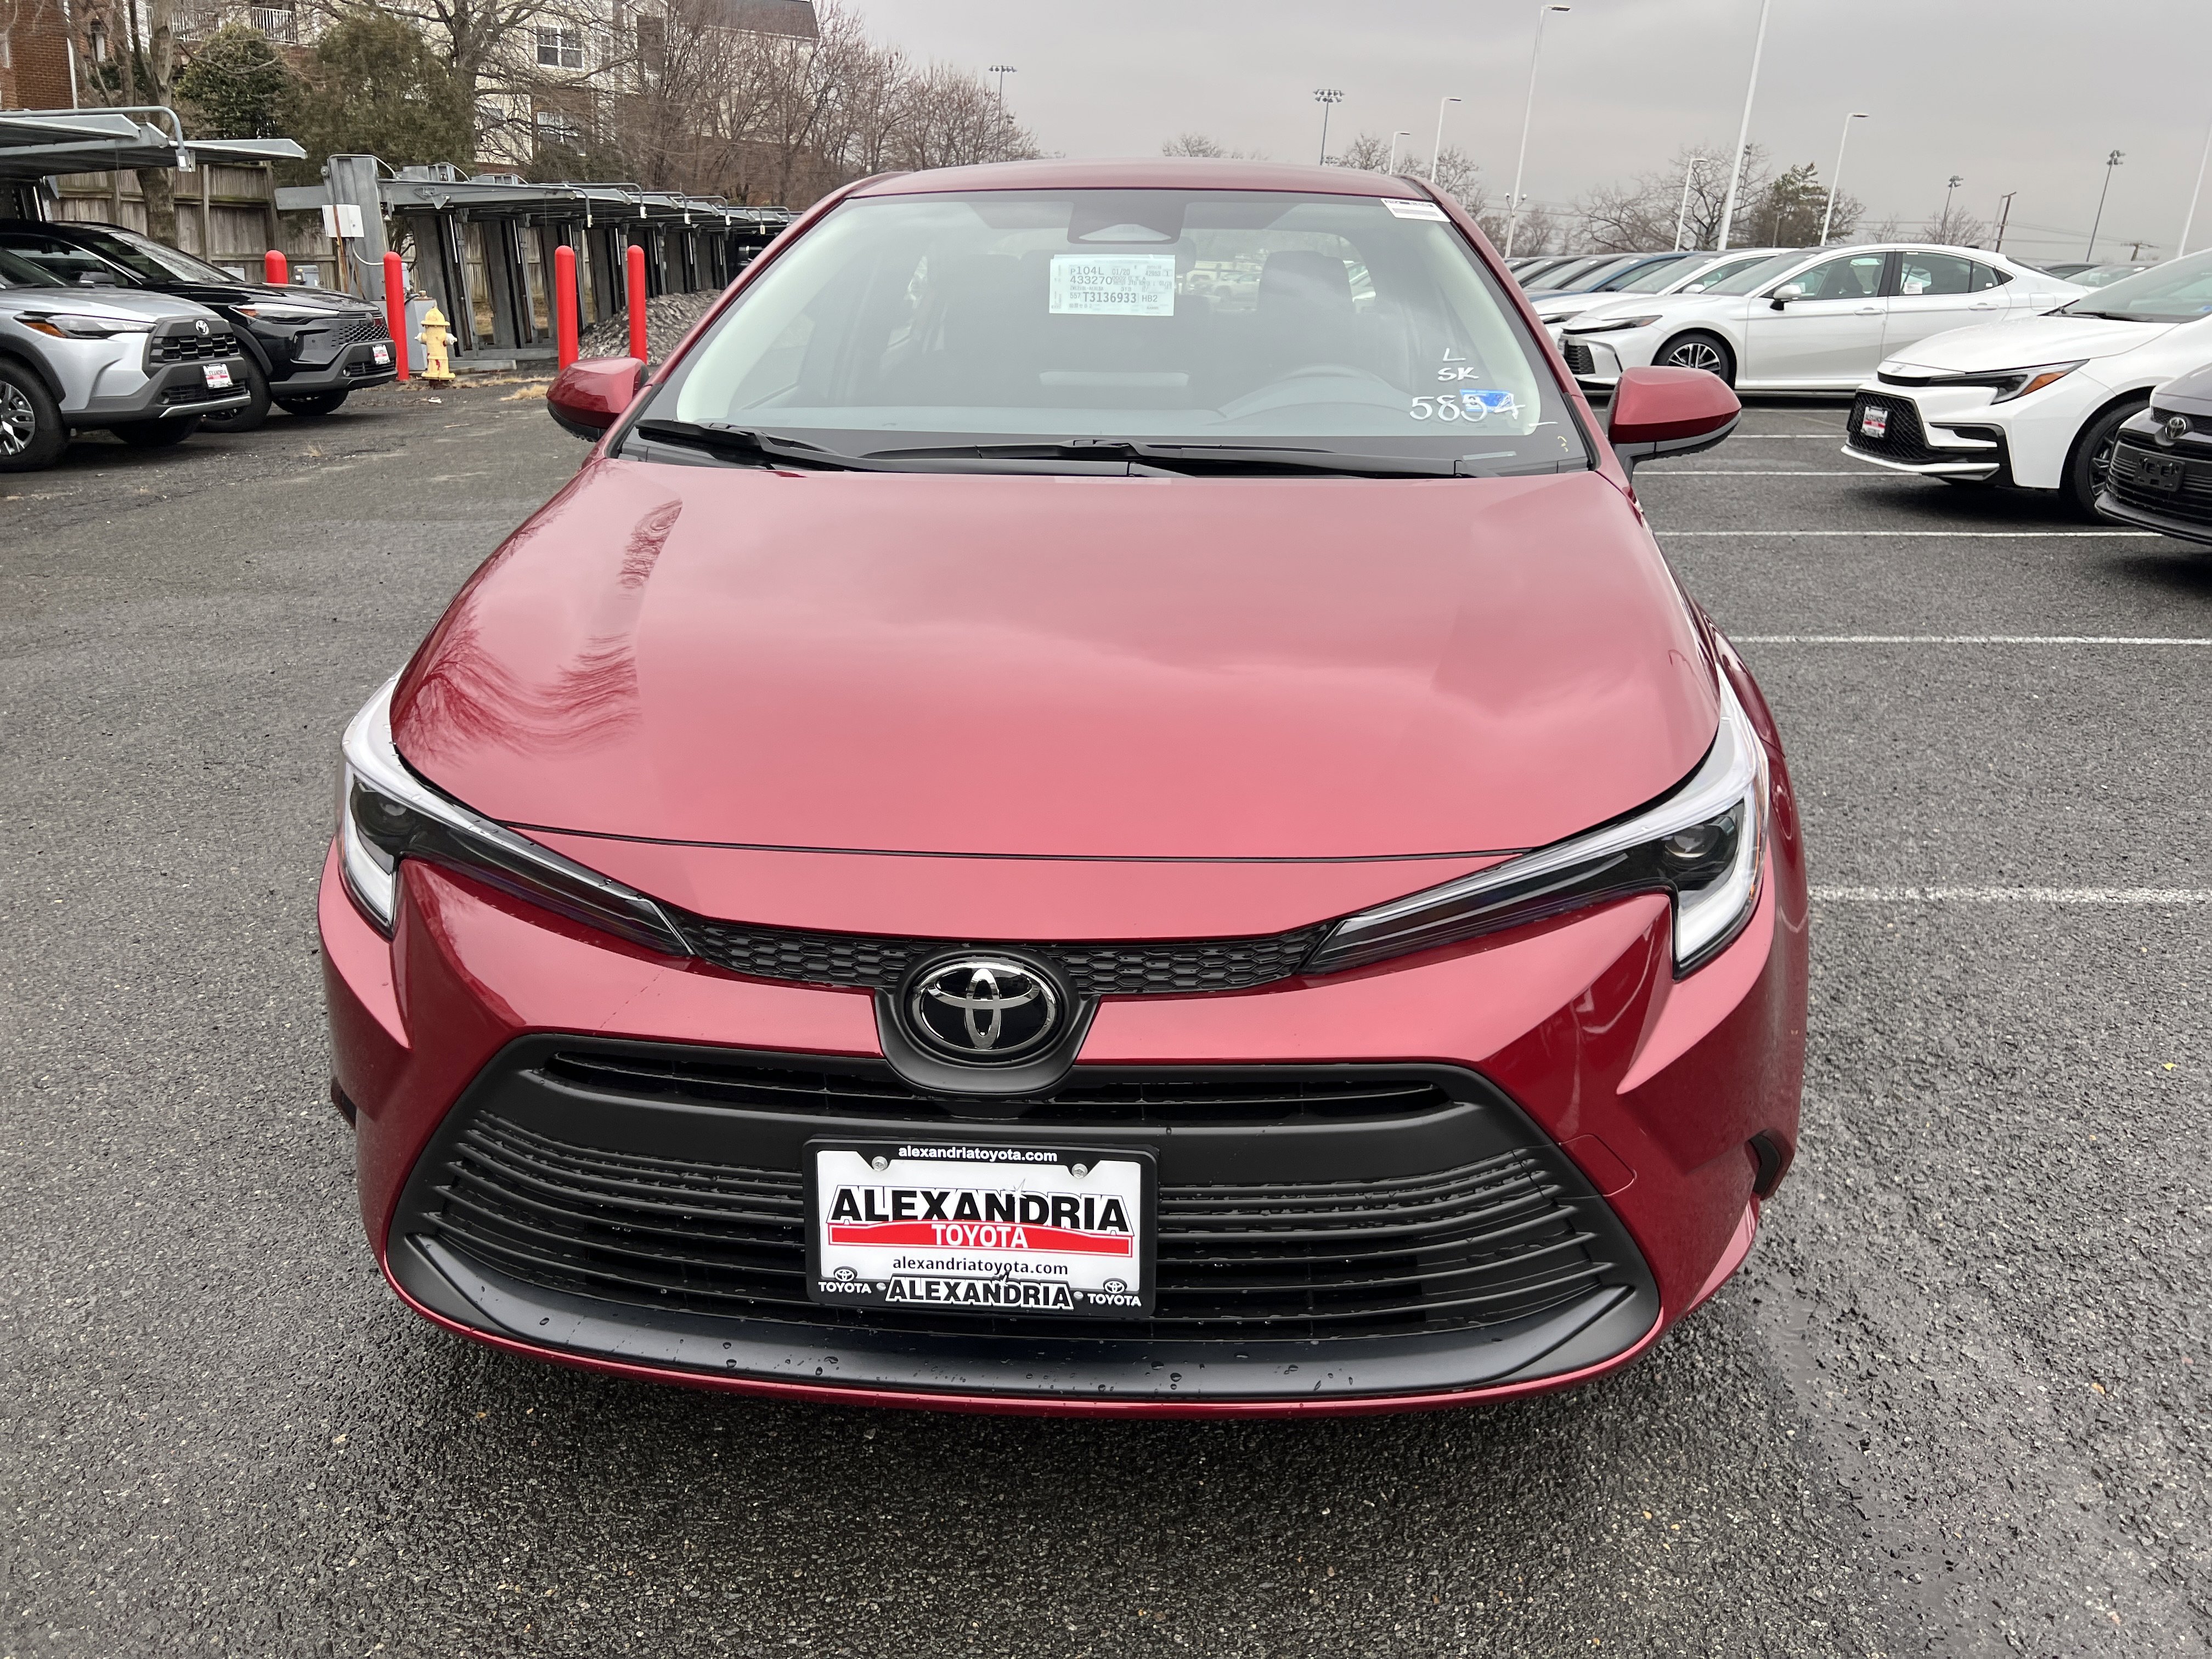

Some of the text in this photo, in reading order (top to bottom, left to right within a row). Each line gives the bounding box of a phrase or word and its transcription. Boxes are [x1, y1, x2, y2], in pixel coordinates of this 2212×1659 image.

[1070, 276, 1112, 285] 433270
[1083, 292, 1137, 303] T3136933
[1443, 348, 1466, 362] L
[1437, 367, 1479, 381] SK
[898, 1144, 1058, 1162] alexandriatoyota.com
[828, 1186, 1133, 1234] ALEXANDRIA
[930, 1223, 1029, 1249] TOYOTA
[892, 1255, 1068, 1276] alexandriatoyota.com
[818, 1275, 1142, 1310] TOYOTA ALEXANDRIA TOYOTA
